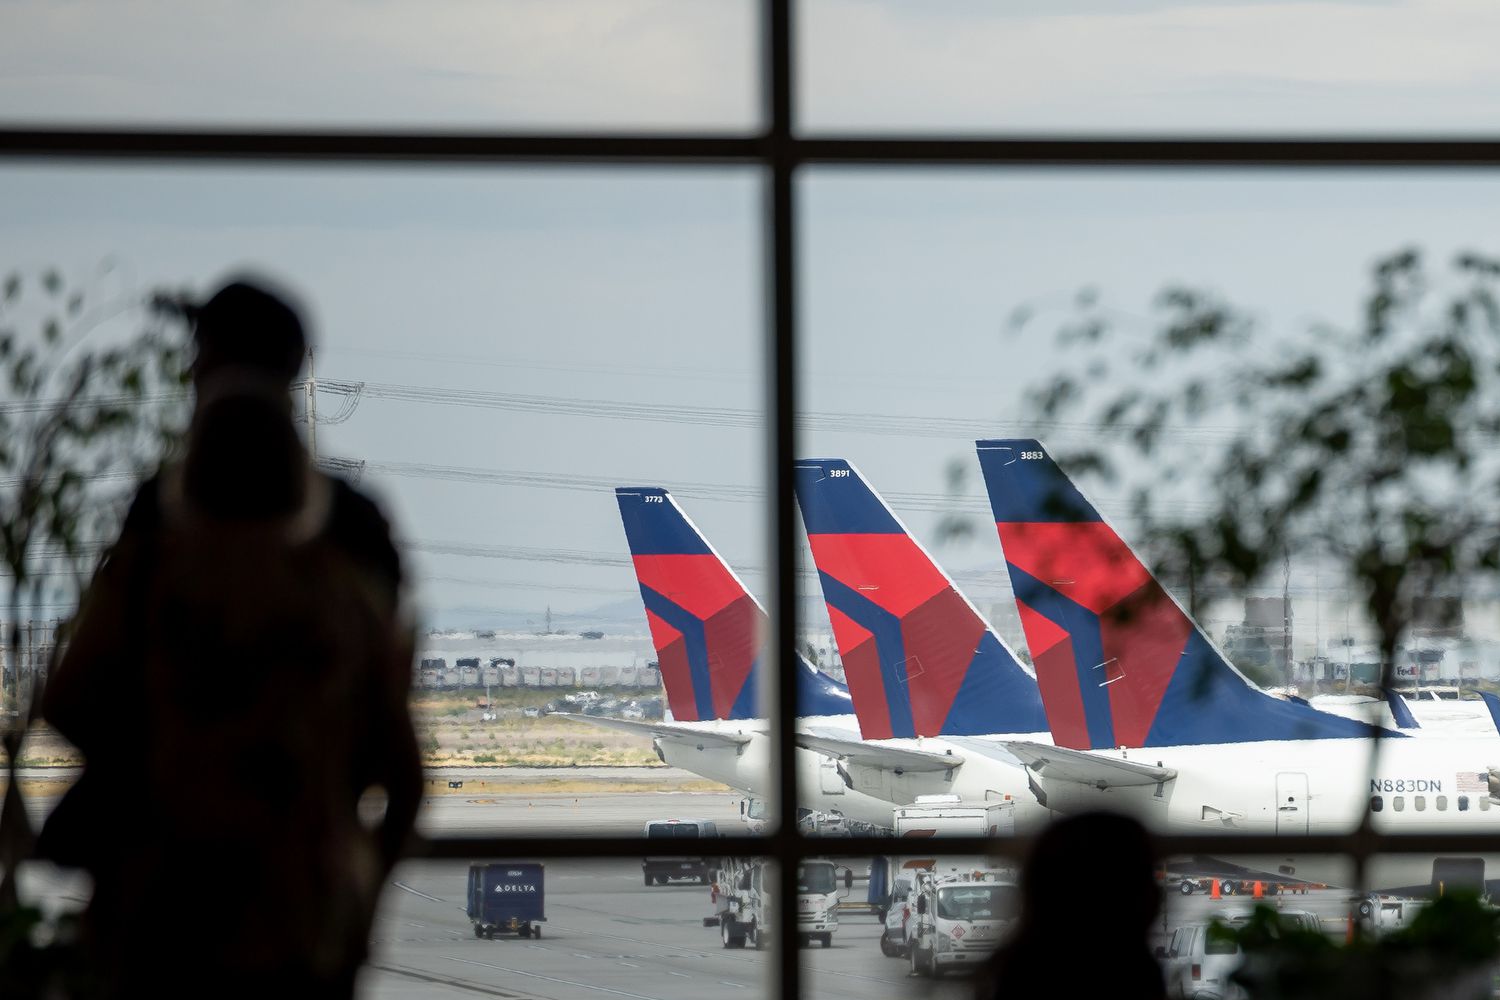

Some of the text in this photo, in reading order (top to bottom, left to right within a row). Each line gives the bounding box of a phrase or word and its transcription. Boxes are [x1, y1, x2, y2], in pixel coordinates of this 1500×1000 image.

[1020, 451, 1043, 460] 3883
[830, 469, 850, 478] 3891
[1370, 779, 1442, 793] N883DN
